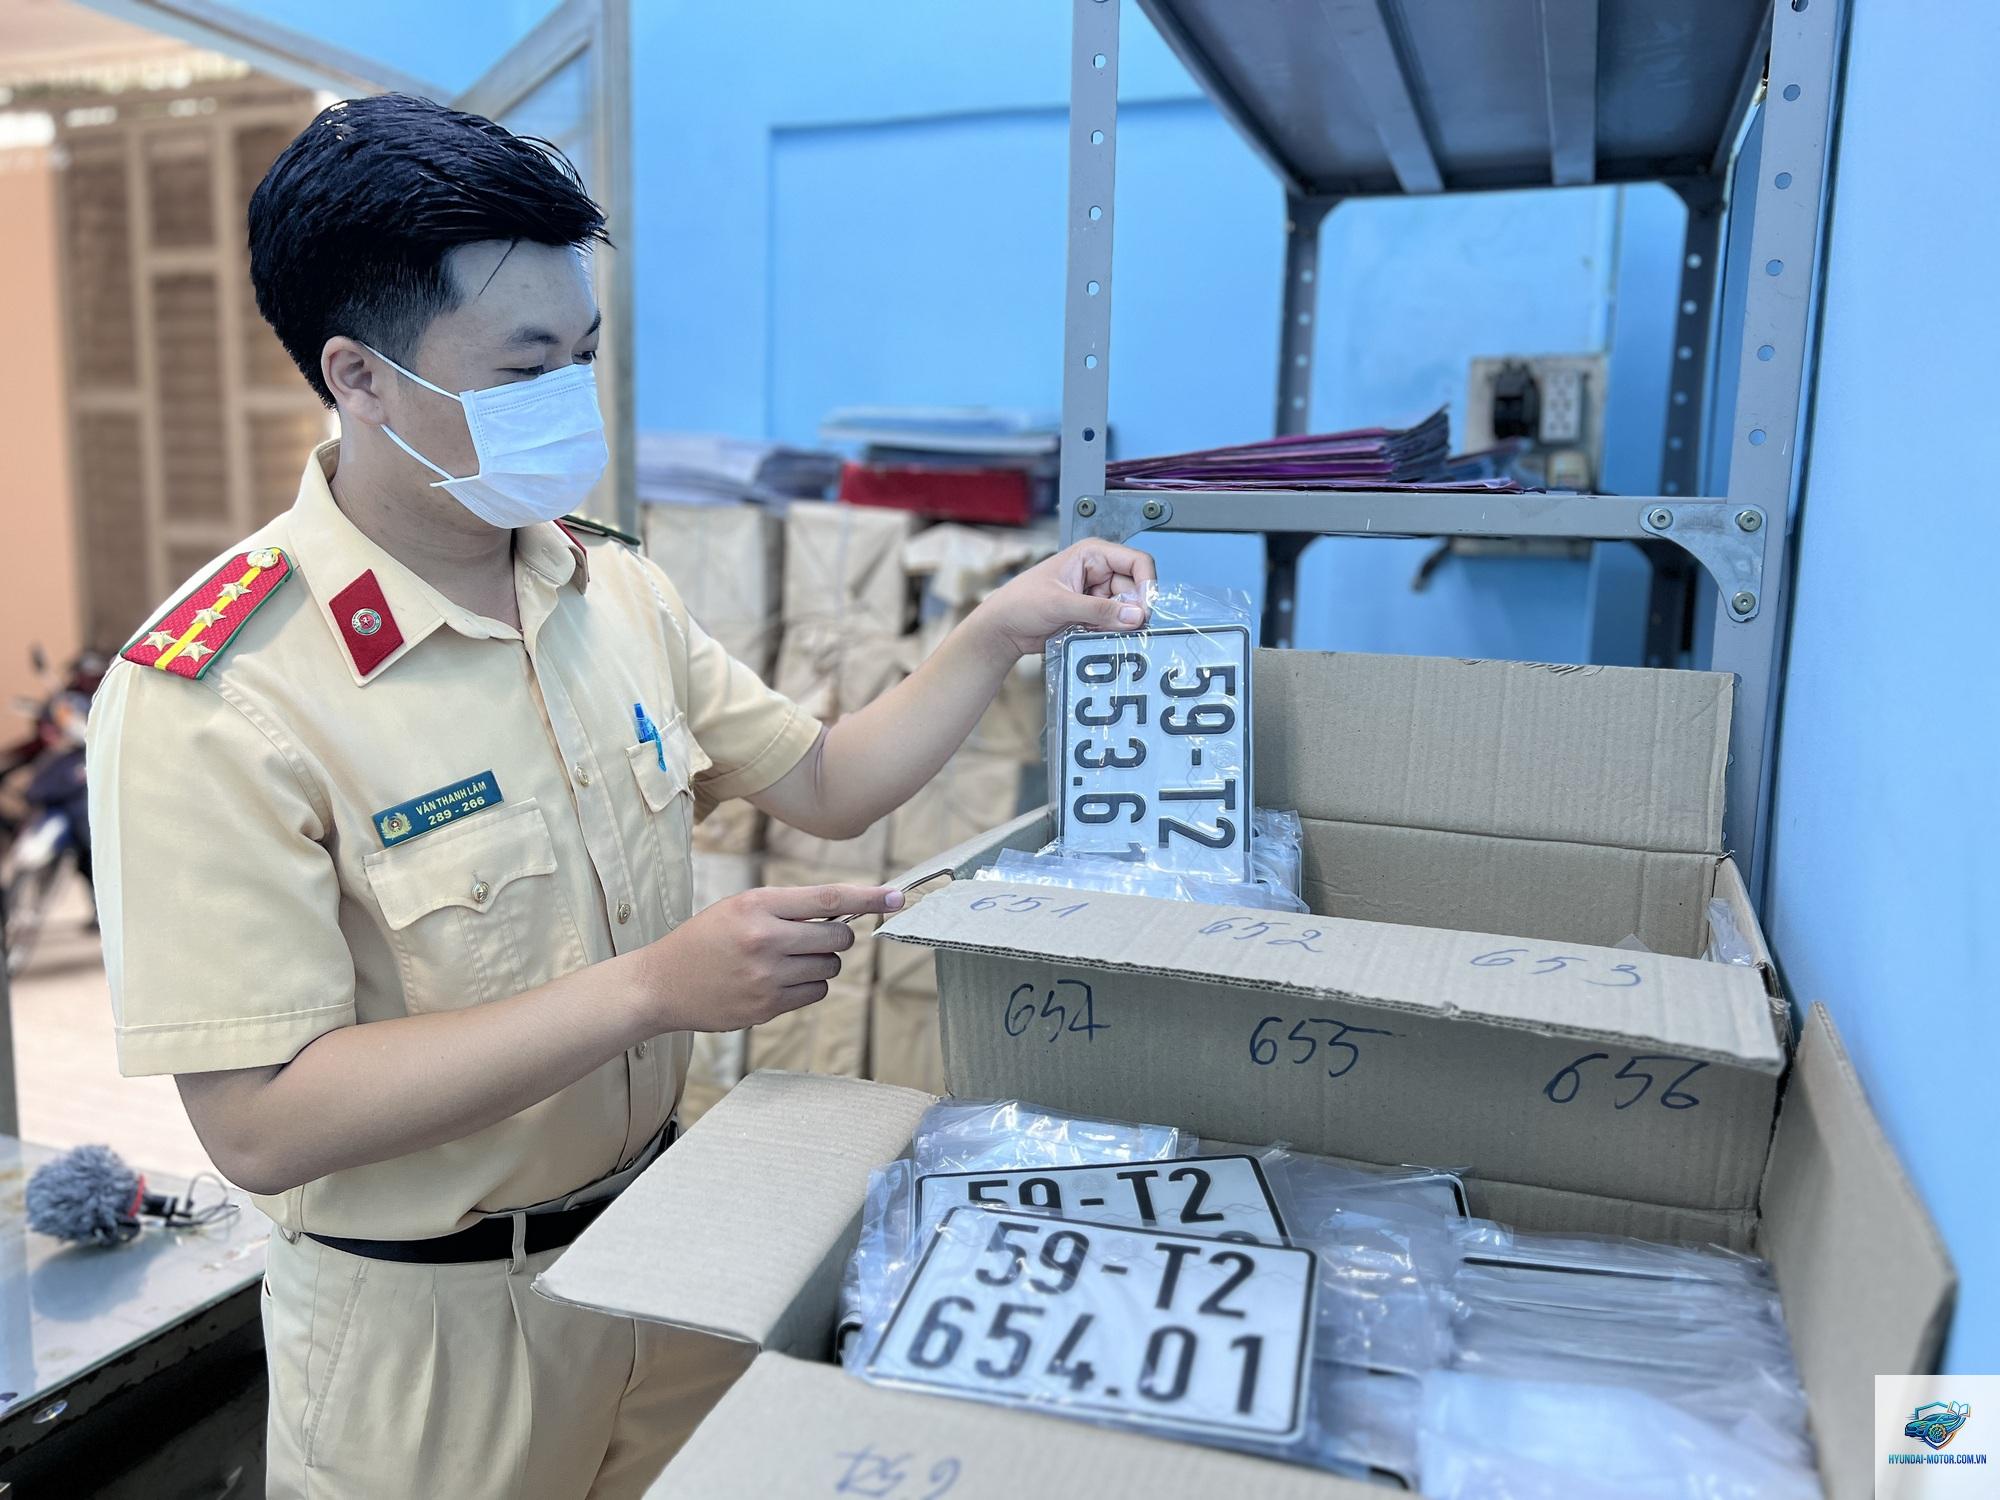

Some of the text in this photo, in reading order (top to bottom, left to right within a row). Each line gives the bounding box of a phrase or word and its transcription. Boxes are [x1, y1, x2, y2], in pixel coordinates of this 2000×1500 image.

[1159, 665, 1236, 849] 59-T2
[415, 801, 437, 816] VĂN
[436, 789, 468, 808] THANH
[428, 809, 452, 825] 289
[461, 796, 486, 812] 266
[970, 894, 1089, 918] 651
[1198, 917, 1324, 952] 652
[1470, 949, 1641, 987] 653
[1250, 1016, 1400, 1078] 655
[1543, 1052, 1709, 1109] 656
[974, 1221, 1257, 1319] 59-T2
[906, 1295, 1264, 1415] 654.01
